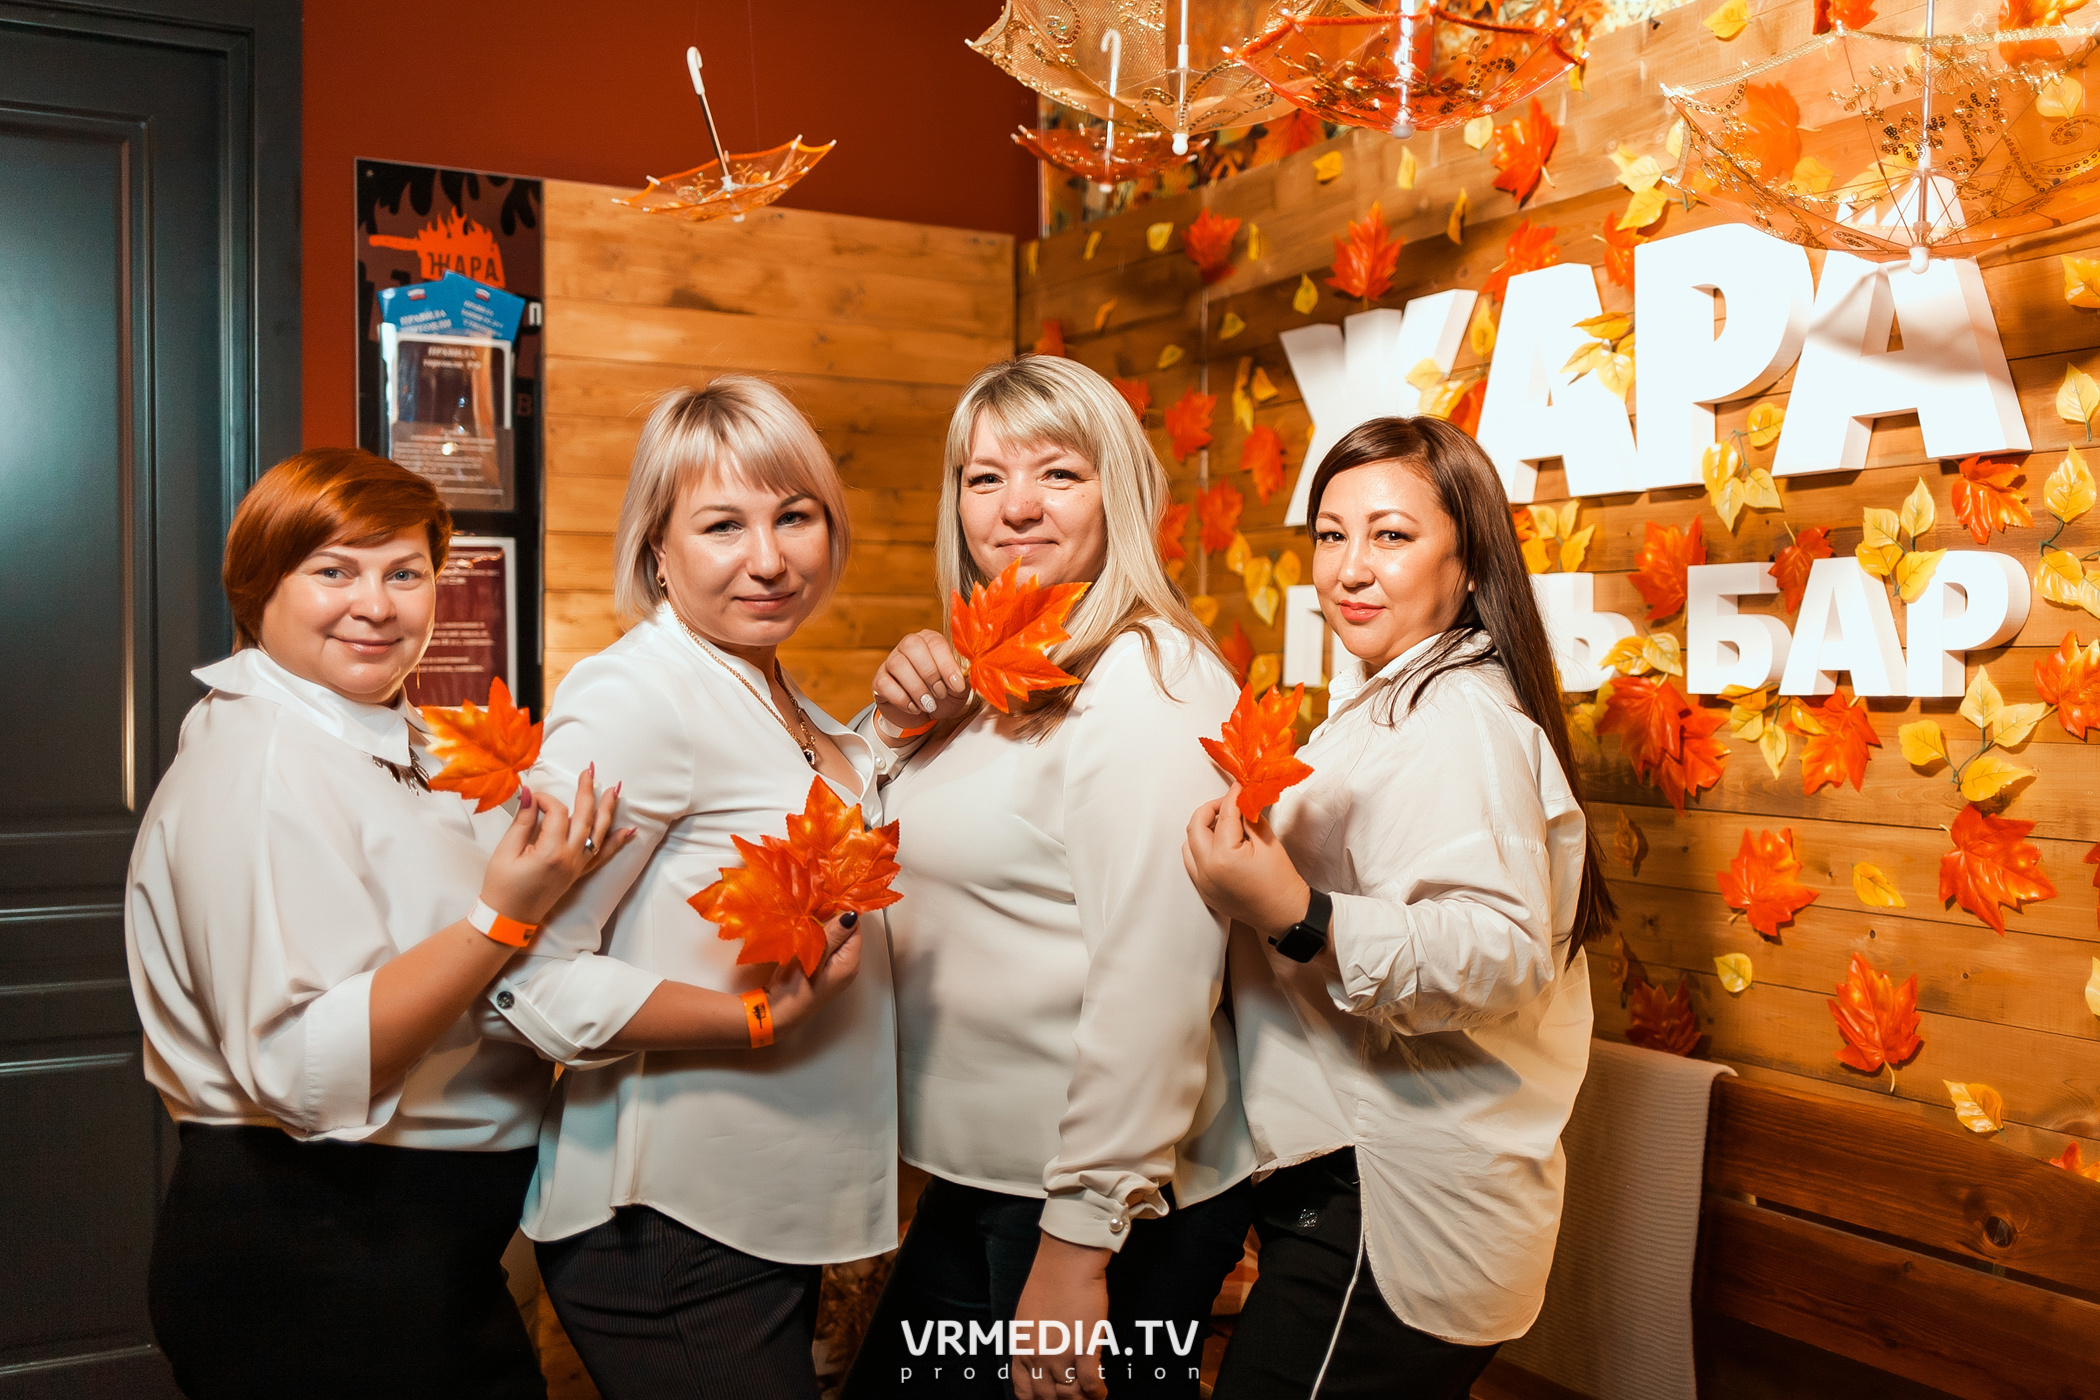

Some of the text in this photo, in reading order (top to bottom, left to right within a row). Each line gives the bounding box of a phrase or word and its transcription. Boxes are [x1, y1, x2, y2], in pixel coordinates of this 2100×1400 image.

[427, 252, 499, 281] ЖАРА
[1279, 174, 2033, 526] ЖАРА
[1687, 550, 2031, 698] БАР
